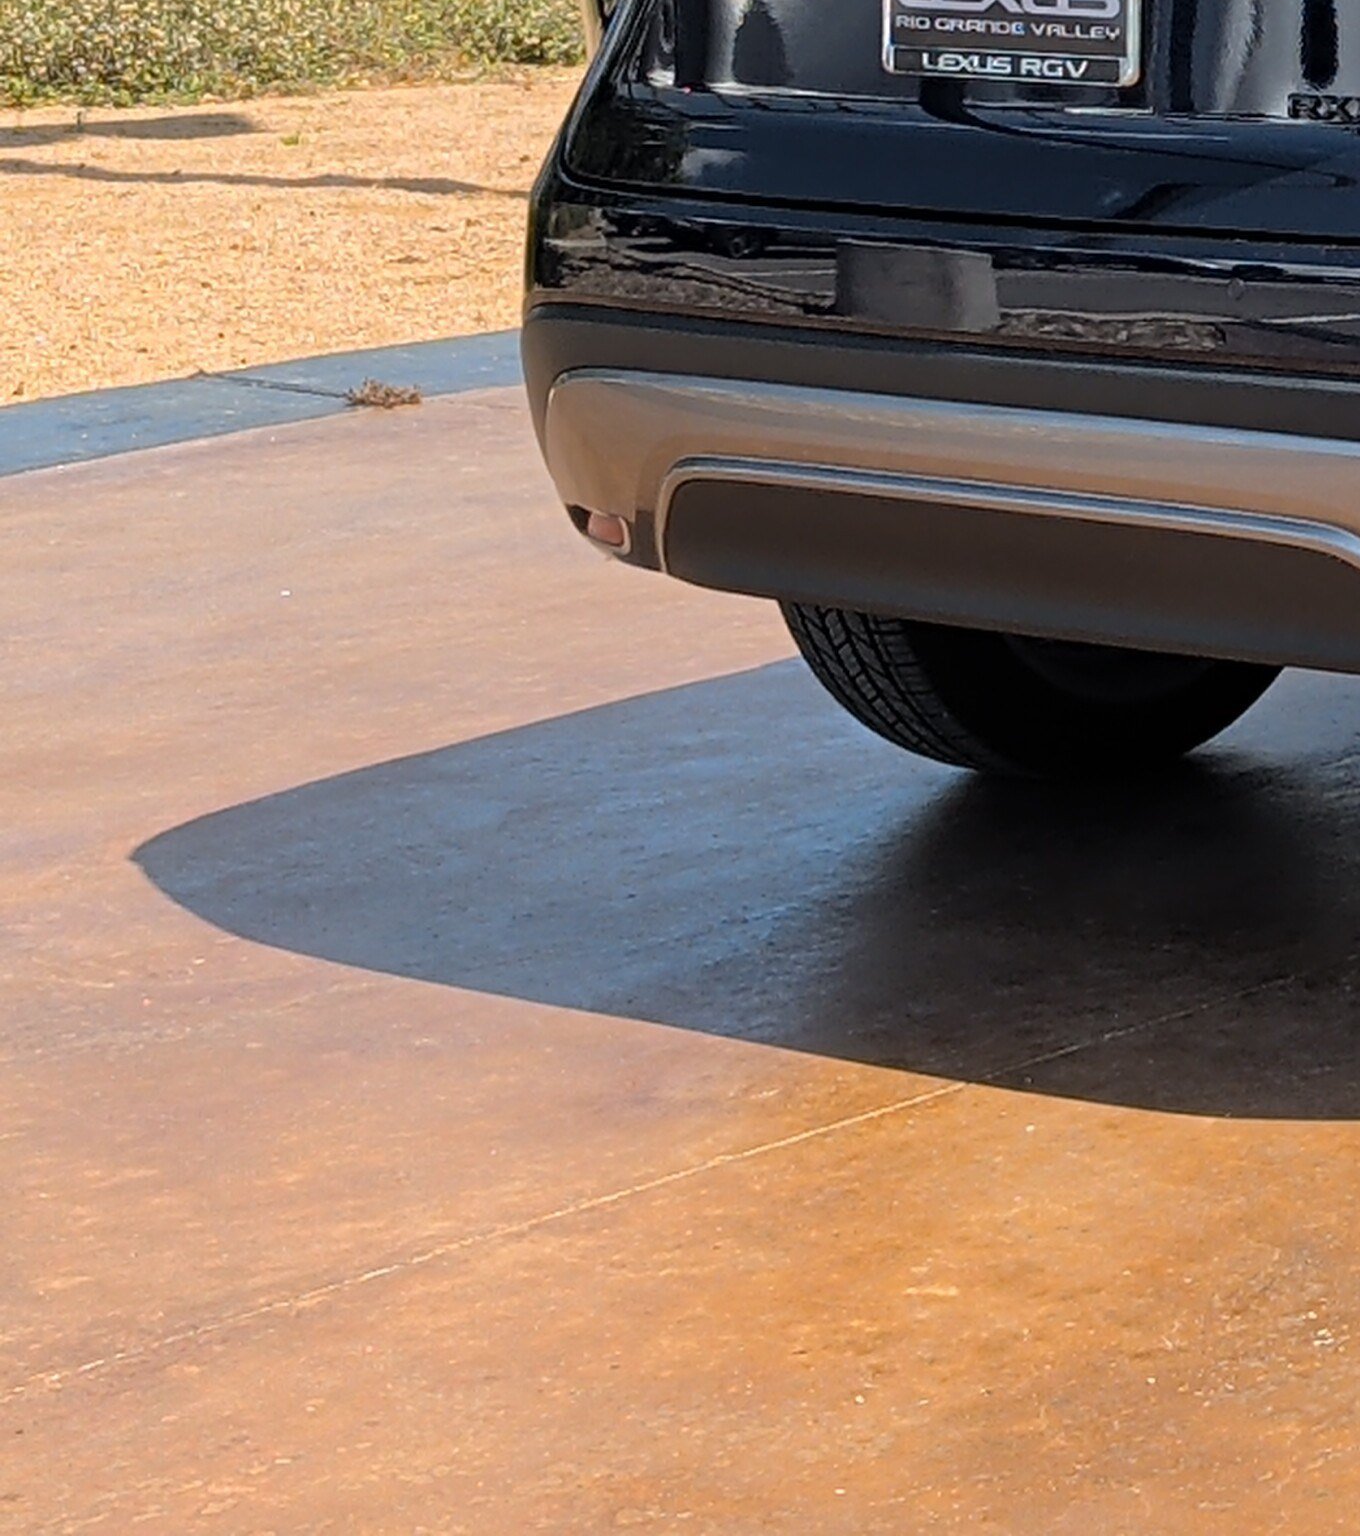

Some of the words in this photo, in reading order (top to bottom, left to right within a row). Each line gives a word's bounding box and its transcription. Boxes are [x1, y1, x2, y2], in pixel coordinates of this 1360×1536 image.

[895, 14, 931, 31] RIO
[934, 16, 1025, 36] GRANDE
[1029, 22, 1121, 41] VALLEY
[921, 51, 1012, 74] LEXUS
[1019, 57, 1089, 79] RGV
